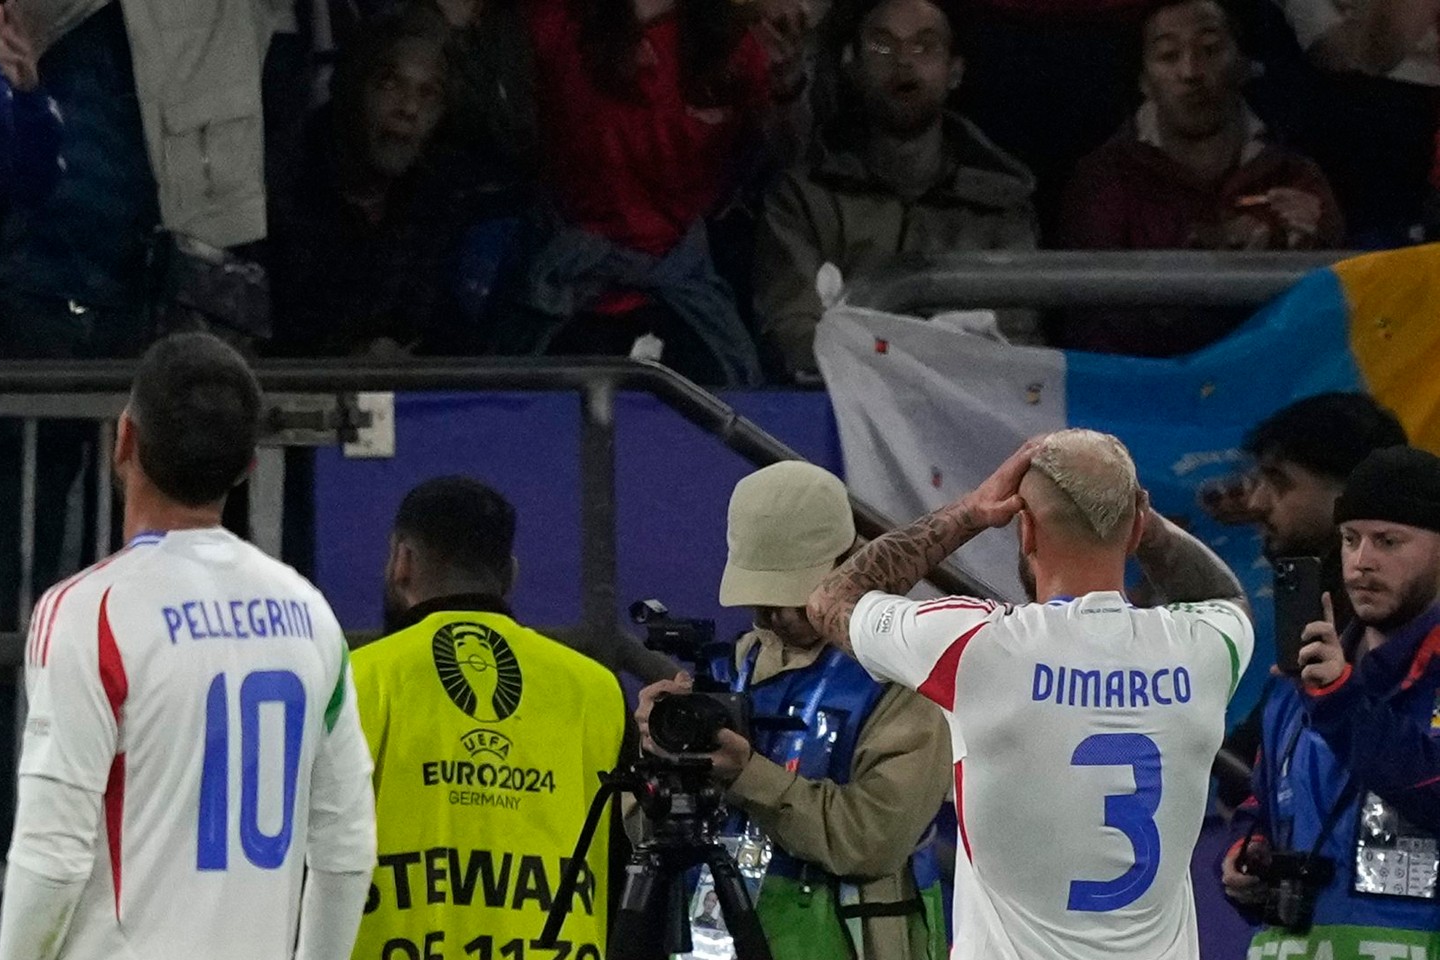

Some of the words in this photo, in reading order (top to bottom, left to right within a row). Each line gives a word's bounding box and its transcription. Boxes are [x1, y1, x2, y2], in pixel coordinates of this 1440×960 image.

[162, 598, 315, 645] PELLEGRINI
[1031, 663, 1191, 708] DIMARCO
[463, 733, 510, 758] UEFA
[196, 670, 306, 872] 10
[422, 760, 556, 793] EURO2024
[448, 791, 521, 810] GERMANY
[1066, 733, 1163, 912] 3
